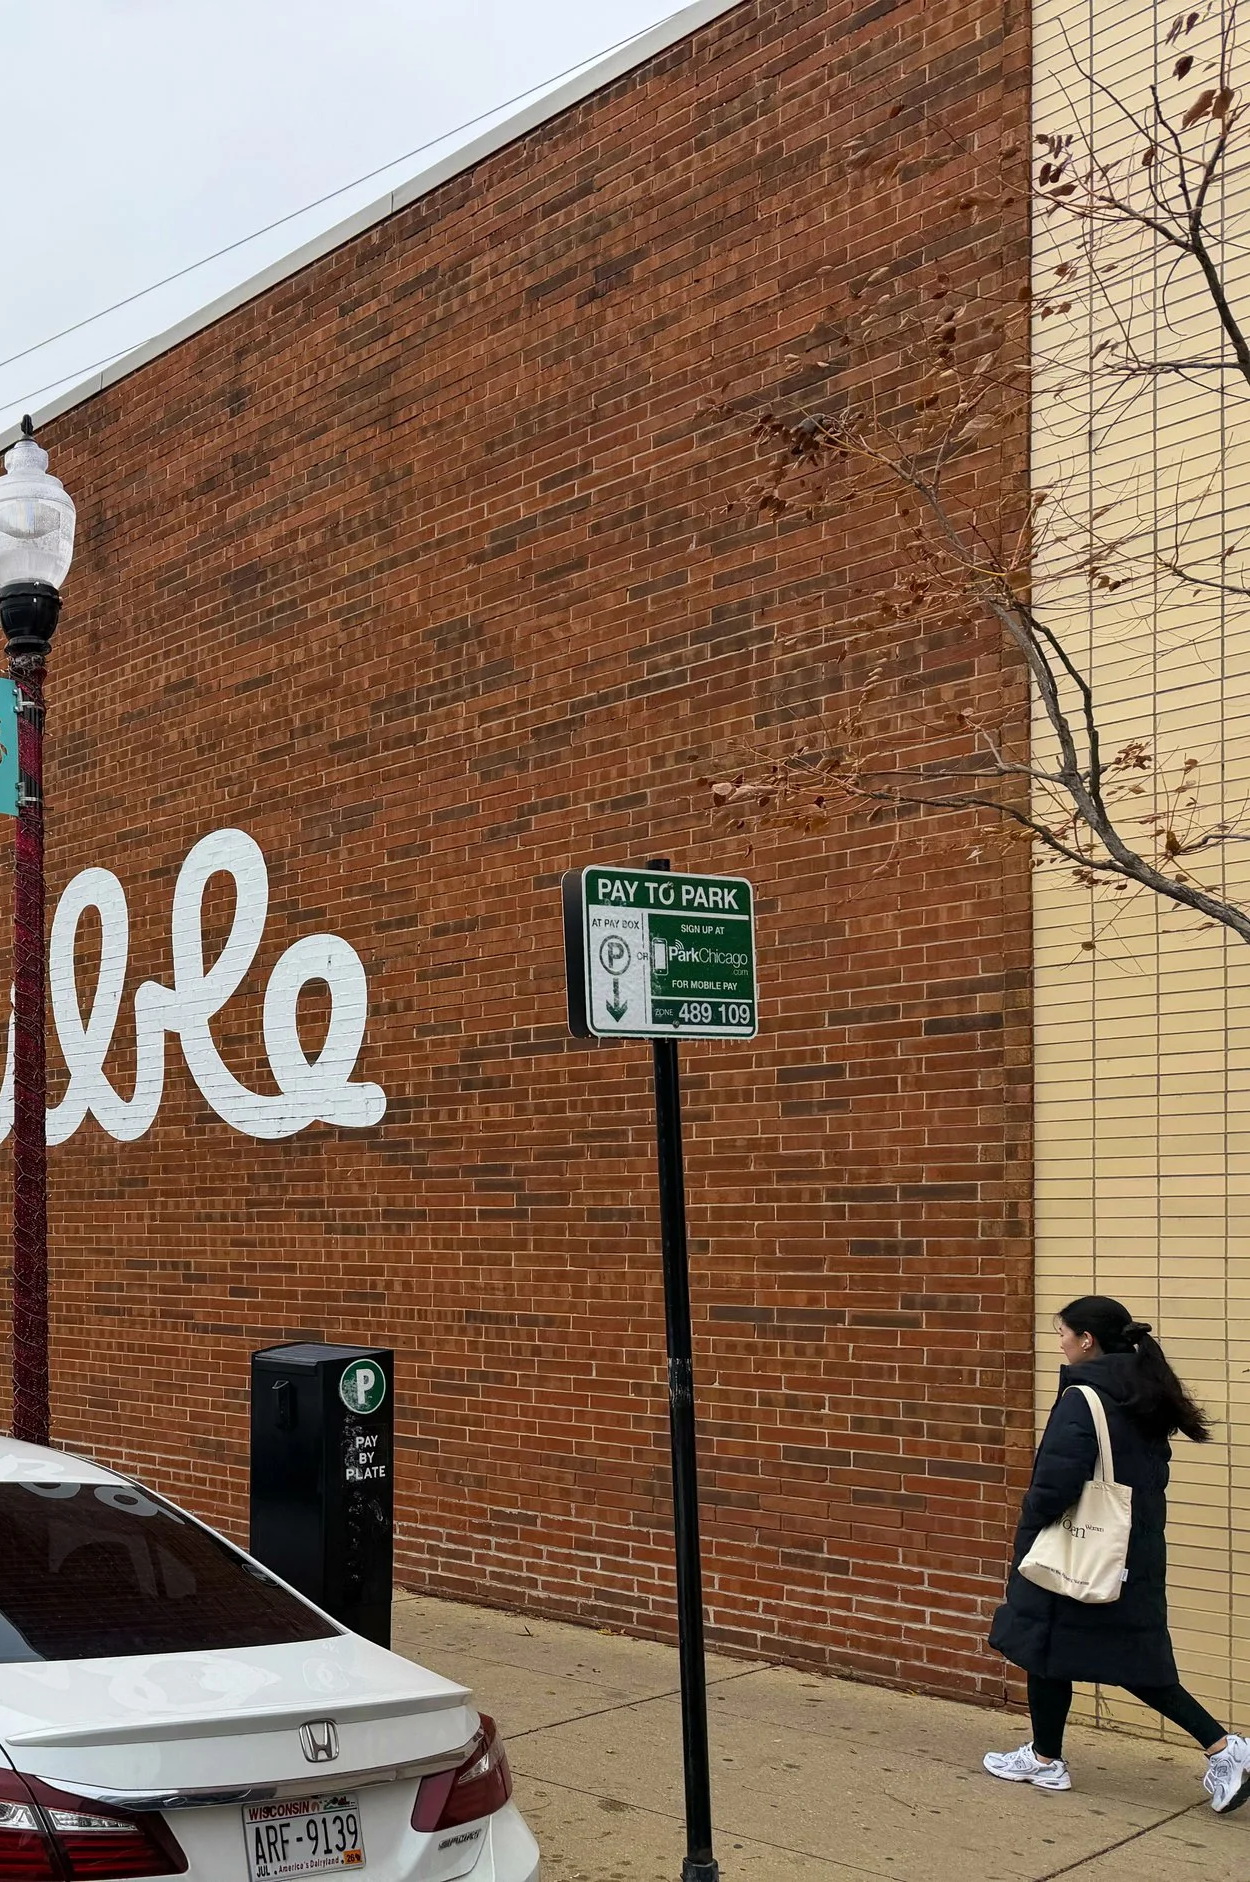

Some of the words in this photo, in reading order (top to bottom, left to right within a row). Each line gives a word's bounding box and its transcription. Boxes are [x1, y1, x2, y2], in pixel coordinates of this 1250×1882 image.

[597, 878, 638, 901] PAY
[645, 881, 675, 905] TO
[681, 885, 739, 910] PARK
[591, 918, 601, 928] AT
[604, 919, 619, 928] PAY
[621, 920, 640, 929] BOX
[681, 924, 700, 934] SIGN
[702, 925, 713, 934] UP
[715, 926, 725, 935] AT
[637, 951, 649, 961] OR
[669, 946, 748, 968] ParkChicago
[672, 979, 689, 989] FOR
[690, 980, 721, 990] MOBILE
[723, 982, 738, 991] PAY
[655, 1007, 674, 1016] ZONE
[678, 1003, 712, 1023] 489
[718, 1005, 750, 1024] 109
[355, 1435, 378, 1448] PAY
[359, 1452, 375, 1465] BY
[346, 1465, 386, 1481] PLATE
[248, 1801, 310, 1821] WISCONSIN
[254, 1813, 359, 1866] ARF-9139
[256, 1865, 271, 1878] JUL
[278, 1861, 309, 1874] America's
[310, 1856, 340, 1869] Dairyland
